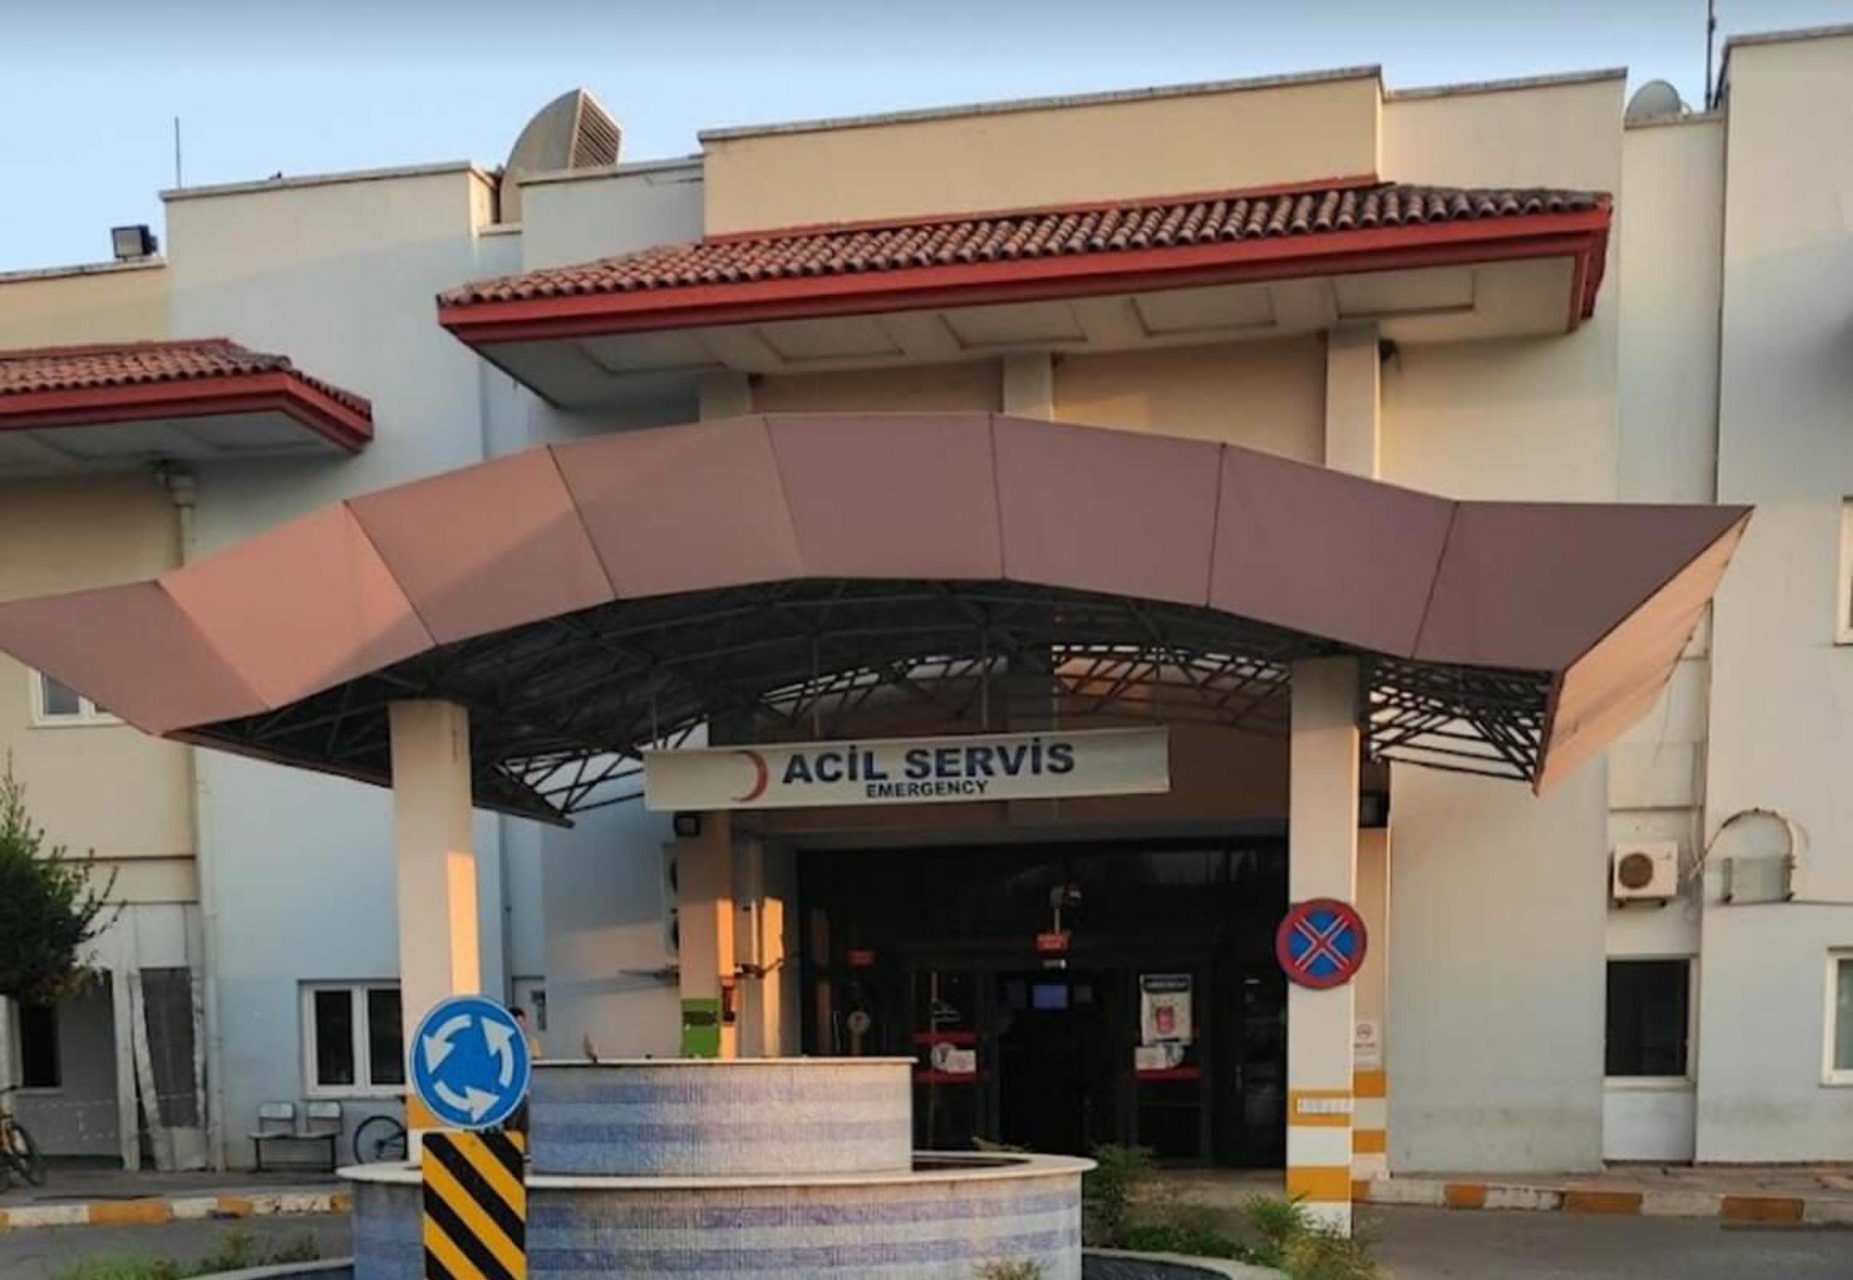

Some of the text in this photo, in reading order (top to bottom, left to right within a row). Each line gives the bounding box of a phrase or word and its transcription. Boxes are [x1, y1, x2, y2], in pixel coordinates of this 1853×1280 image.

[783, 737, 1075, 784] ACİL SERVİS
[866, 780, 989, 798] EMERGENCY
